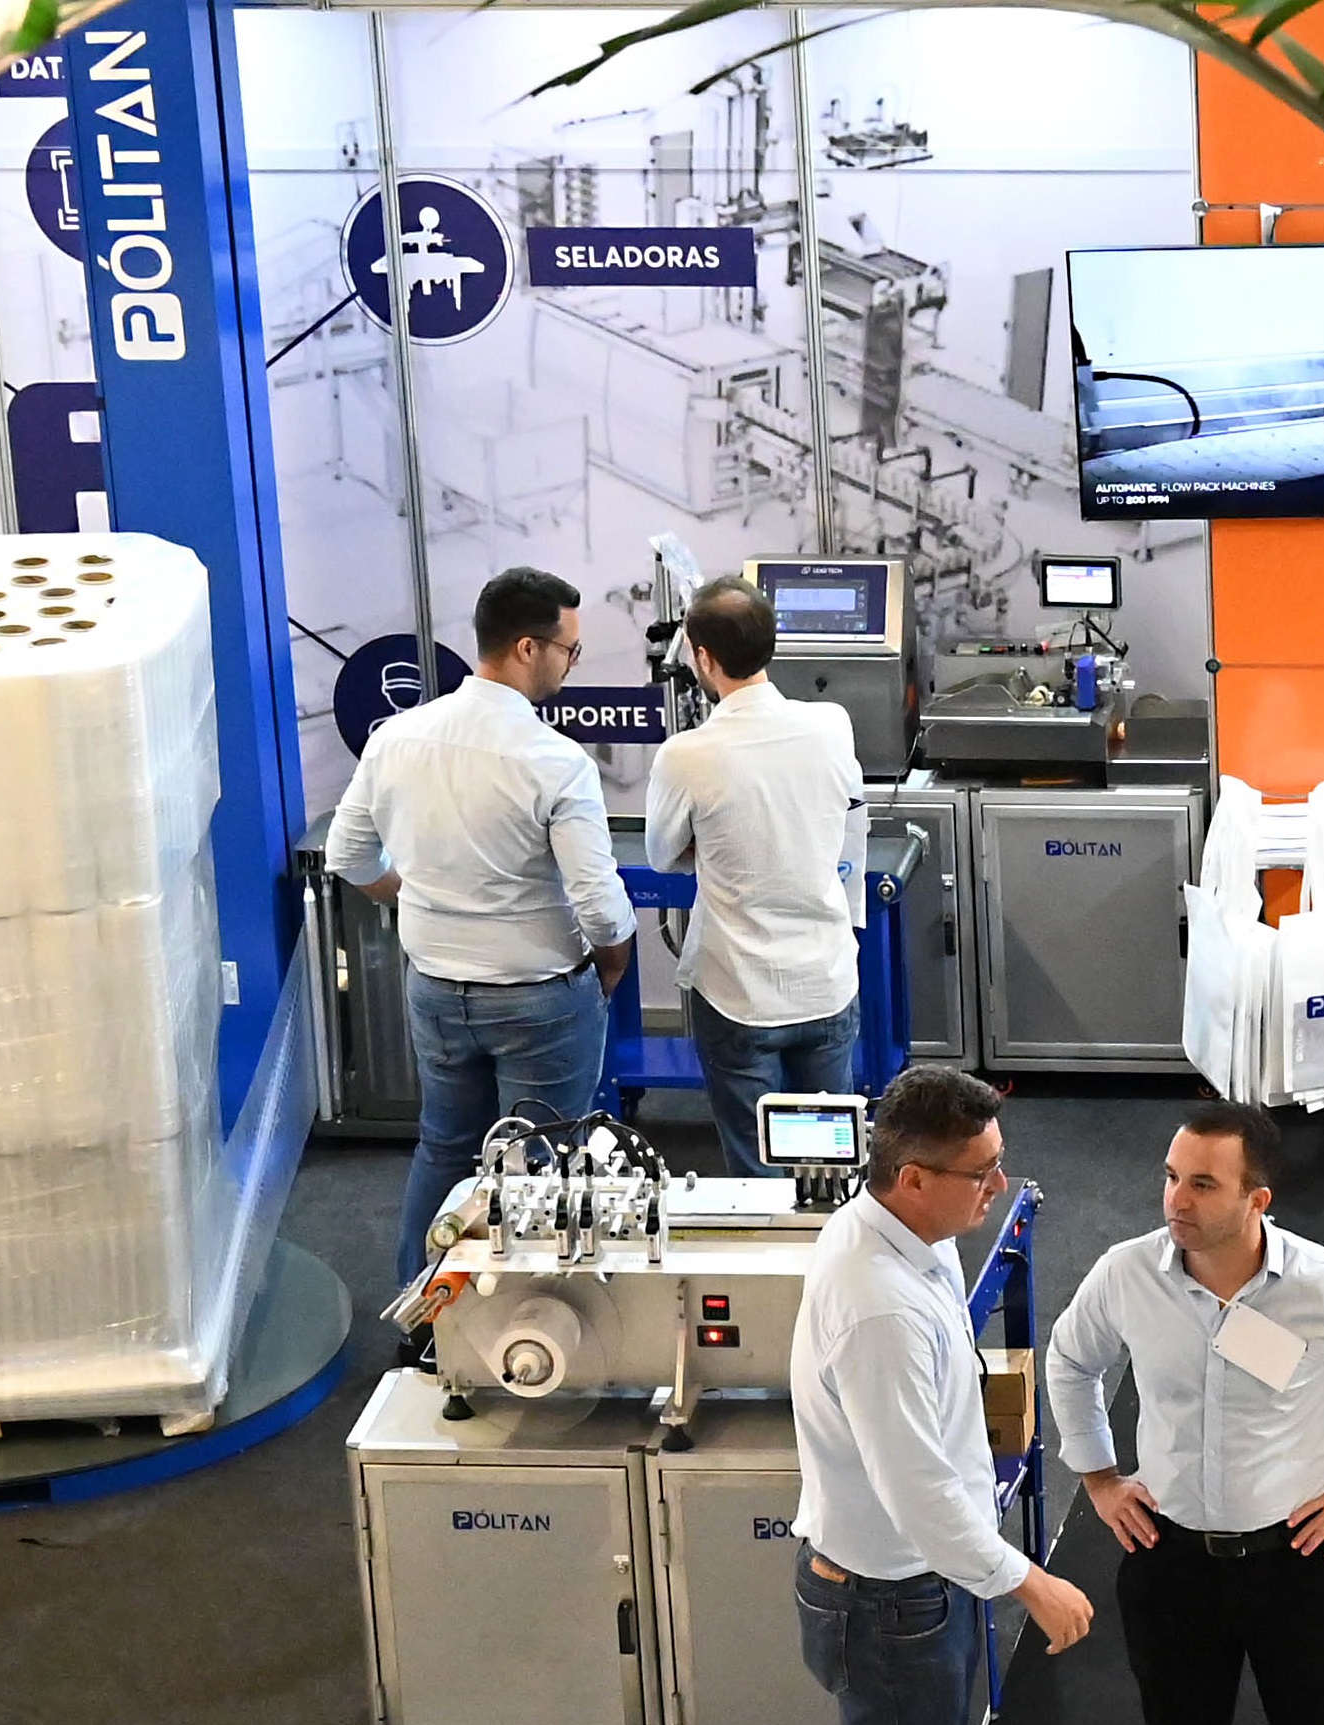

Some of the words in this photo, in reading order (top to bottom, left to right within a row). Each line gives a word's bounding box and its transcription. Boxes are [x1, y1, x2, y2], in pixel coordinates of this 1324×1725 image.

[84, 31, 186, 360] PÓLITAN
[555, 245, 720, 269] SELADORAS
[1095, 483, 1157, 493] AUTOMATIC
[1161, 482, 1191, 492] FLOW
[1193, 482, 1221, 491] PACK
[1222, 481, 1276, 491] MACHINES
[1111, 496, 1125, 504] TO
[453, 1510, 550, 1531] PÓLITAN
